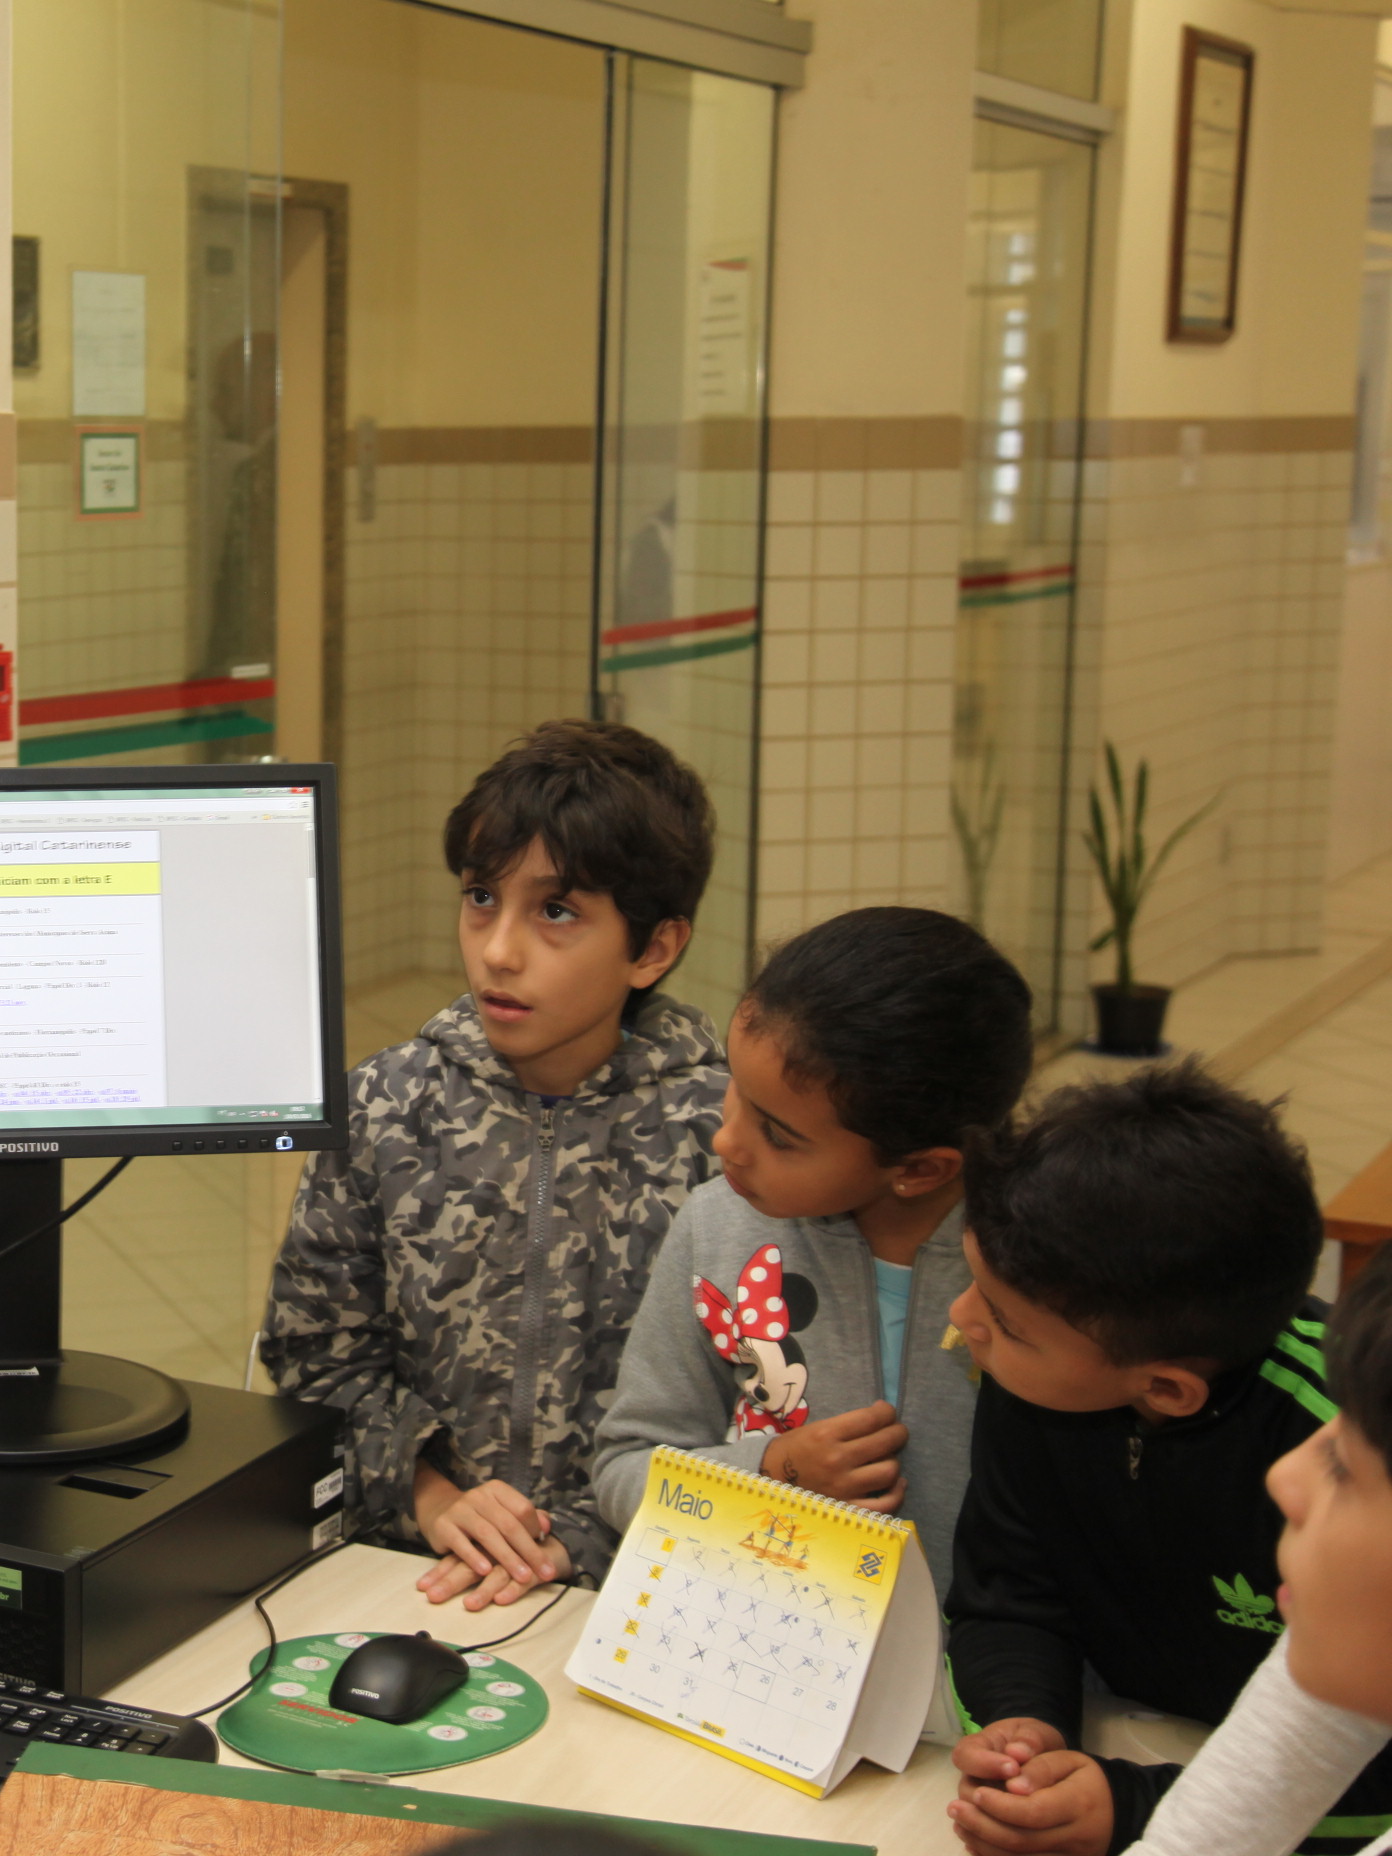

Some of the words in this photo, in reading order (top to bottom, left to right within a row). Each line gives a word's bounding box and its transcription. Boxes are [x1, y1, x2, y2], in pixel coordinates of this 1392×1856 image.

[41, 838, 132, 850] Catarinense
[35, 876, 60, 885] com
[73, 874, 102, 884] letra
[658, 1478, 713, 1520] Maio
[1216, 1608, 1287, 1634] adida
[649, 1663, 660, 1674] 30
[350, 1687, 380, 1700] POSITIVO
[760, 1674, 770, 1684] 26
[792, 1687, 804, 1697] 27
[825, 1700, 837, 1711] 28
[105, 1705, 153, 1719] POSITIVO
